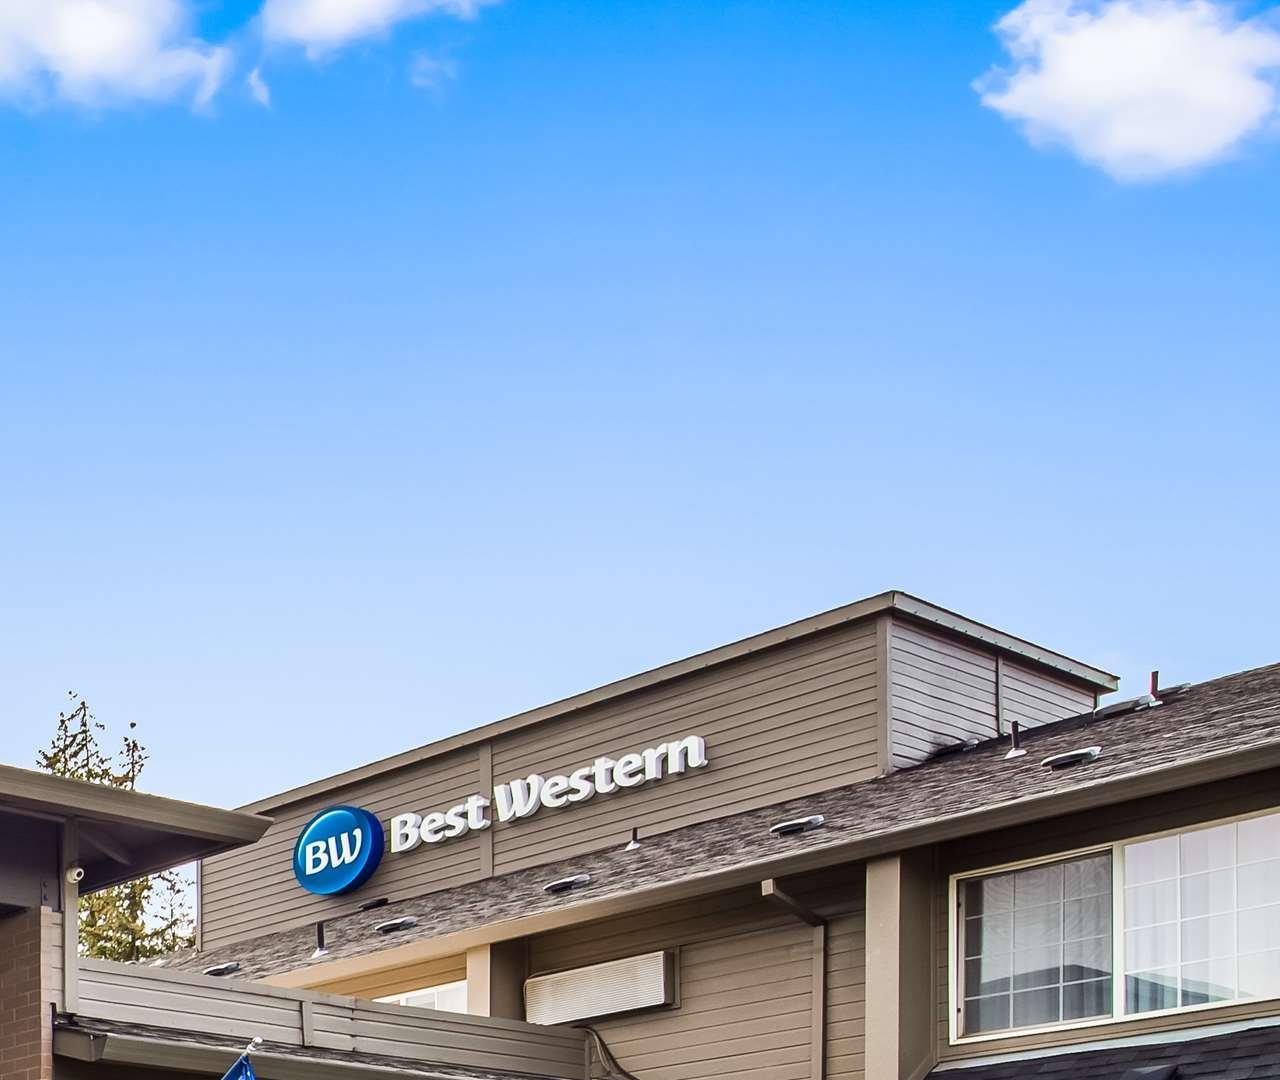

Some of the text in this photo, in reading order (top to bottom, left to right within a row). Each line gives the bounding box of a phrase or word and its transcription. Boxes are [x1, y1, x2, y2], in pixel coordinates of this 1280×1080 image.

[391, 735, 708, 853] Best Western
[305, 827, 363, 876] BW
